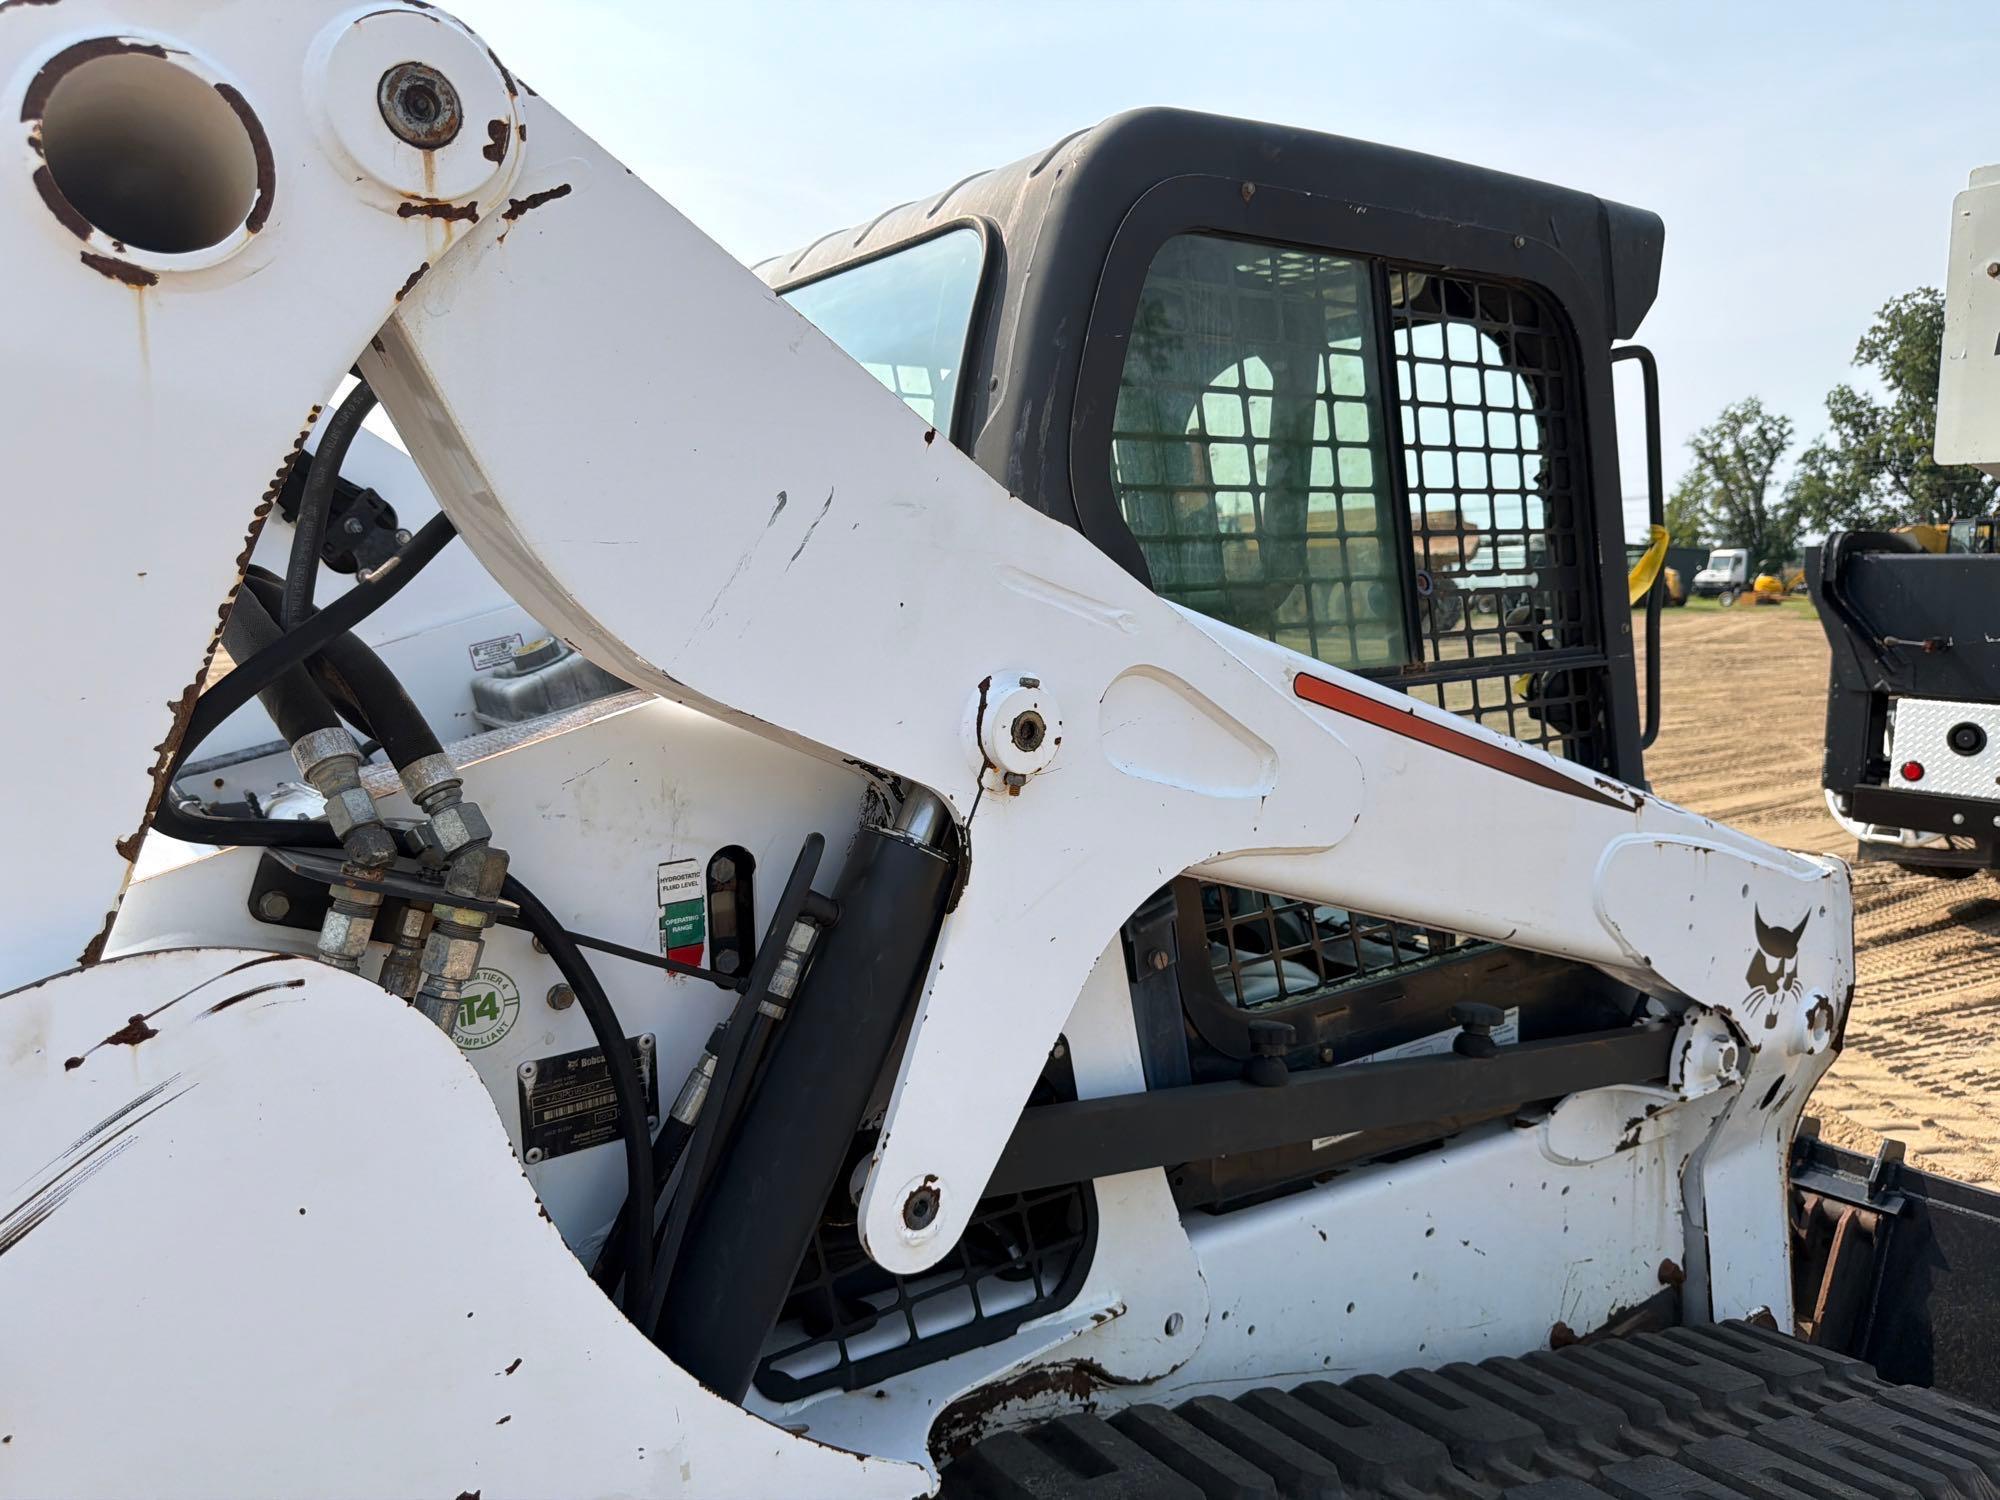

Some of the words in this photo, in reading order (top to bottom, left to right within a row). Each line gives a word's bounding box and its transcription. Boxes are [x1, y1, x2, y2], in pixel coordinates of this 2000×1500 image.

[660, 871, 701, 884] HYDROSTATIC
[662, 883, 680, 892] FLUID
[681, 880, 699, 889] LEVEL
[665, 914, 700, 926] OPERATING
[672, 923, 694, 933] RANGE
[482, 972, 502, 984] TIER
[451, 1021, 508, 1045] COMPLIANT
[581, 1055, 606, 1067] Bobca
